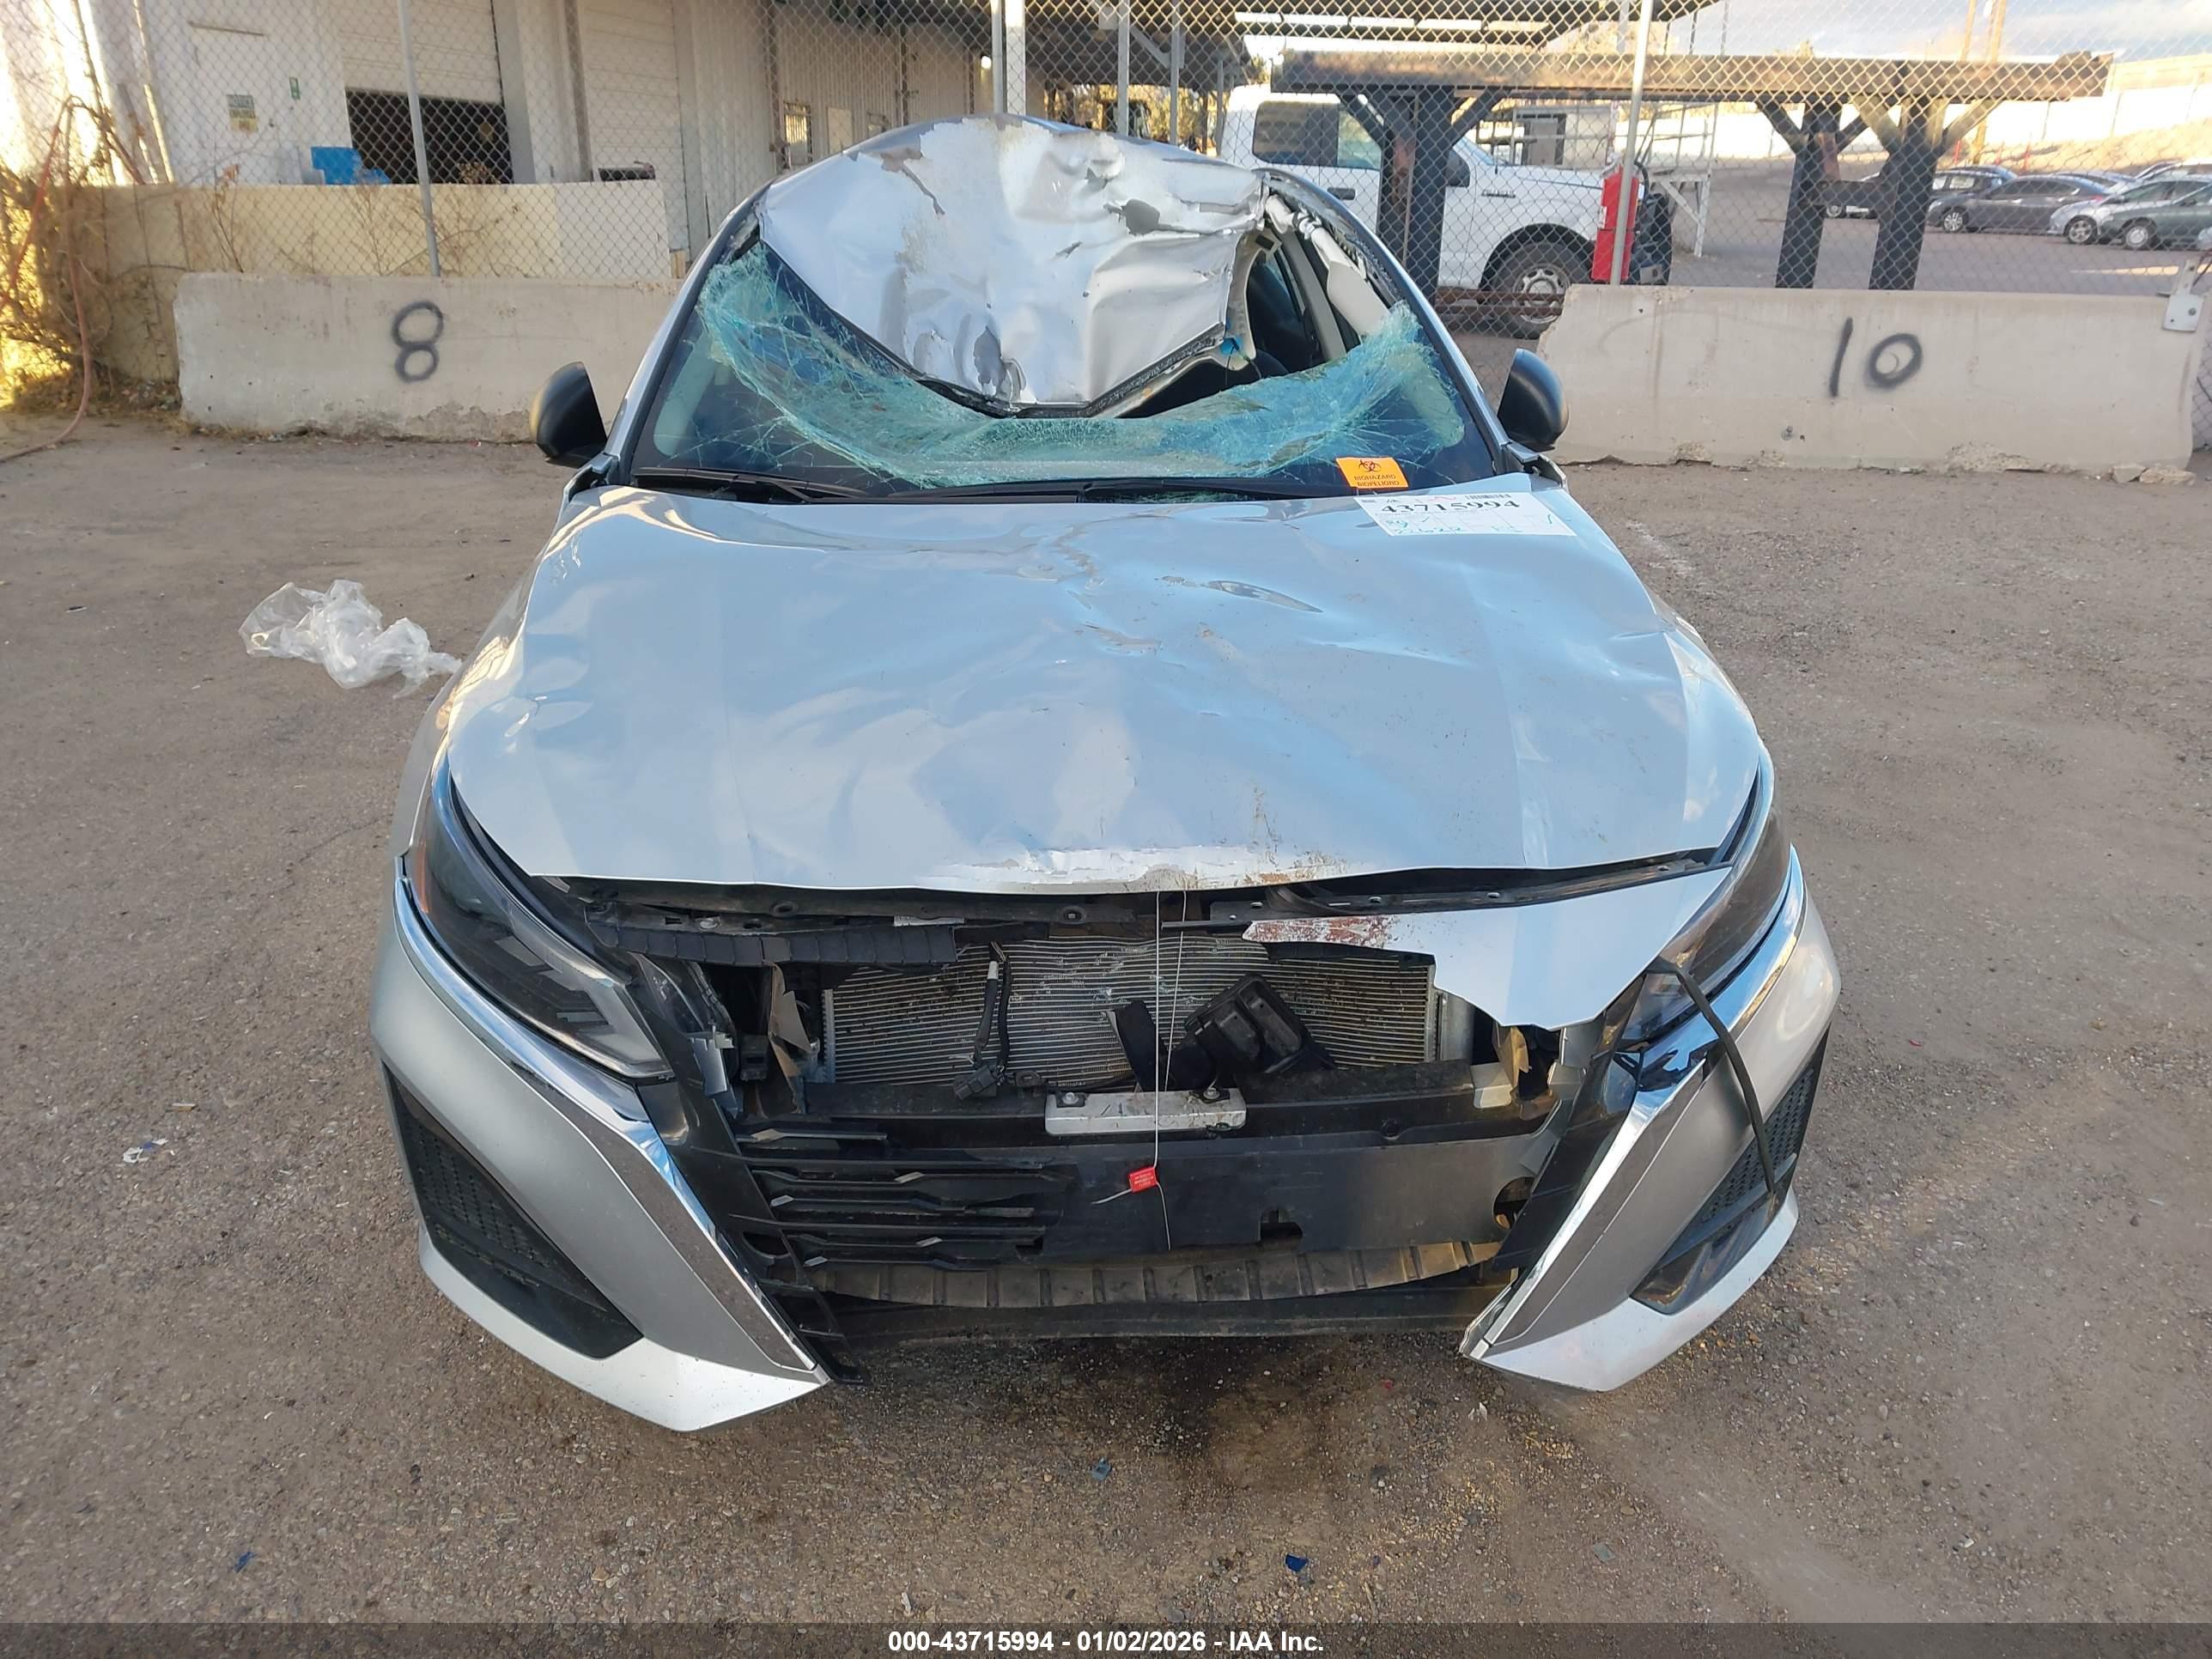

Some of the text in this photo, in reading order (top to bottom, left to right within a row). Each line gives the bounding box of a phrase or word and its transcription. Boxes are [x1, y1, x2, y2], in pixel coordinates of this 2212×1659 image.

[392, 301, 444, 383] 8
[1828, 317, 1923, 397] 10
[1381, 500, 1520, 513] 43715994
